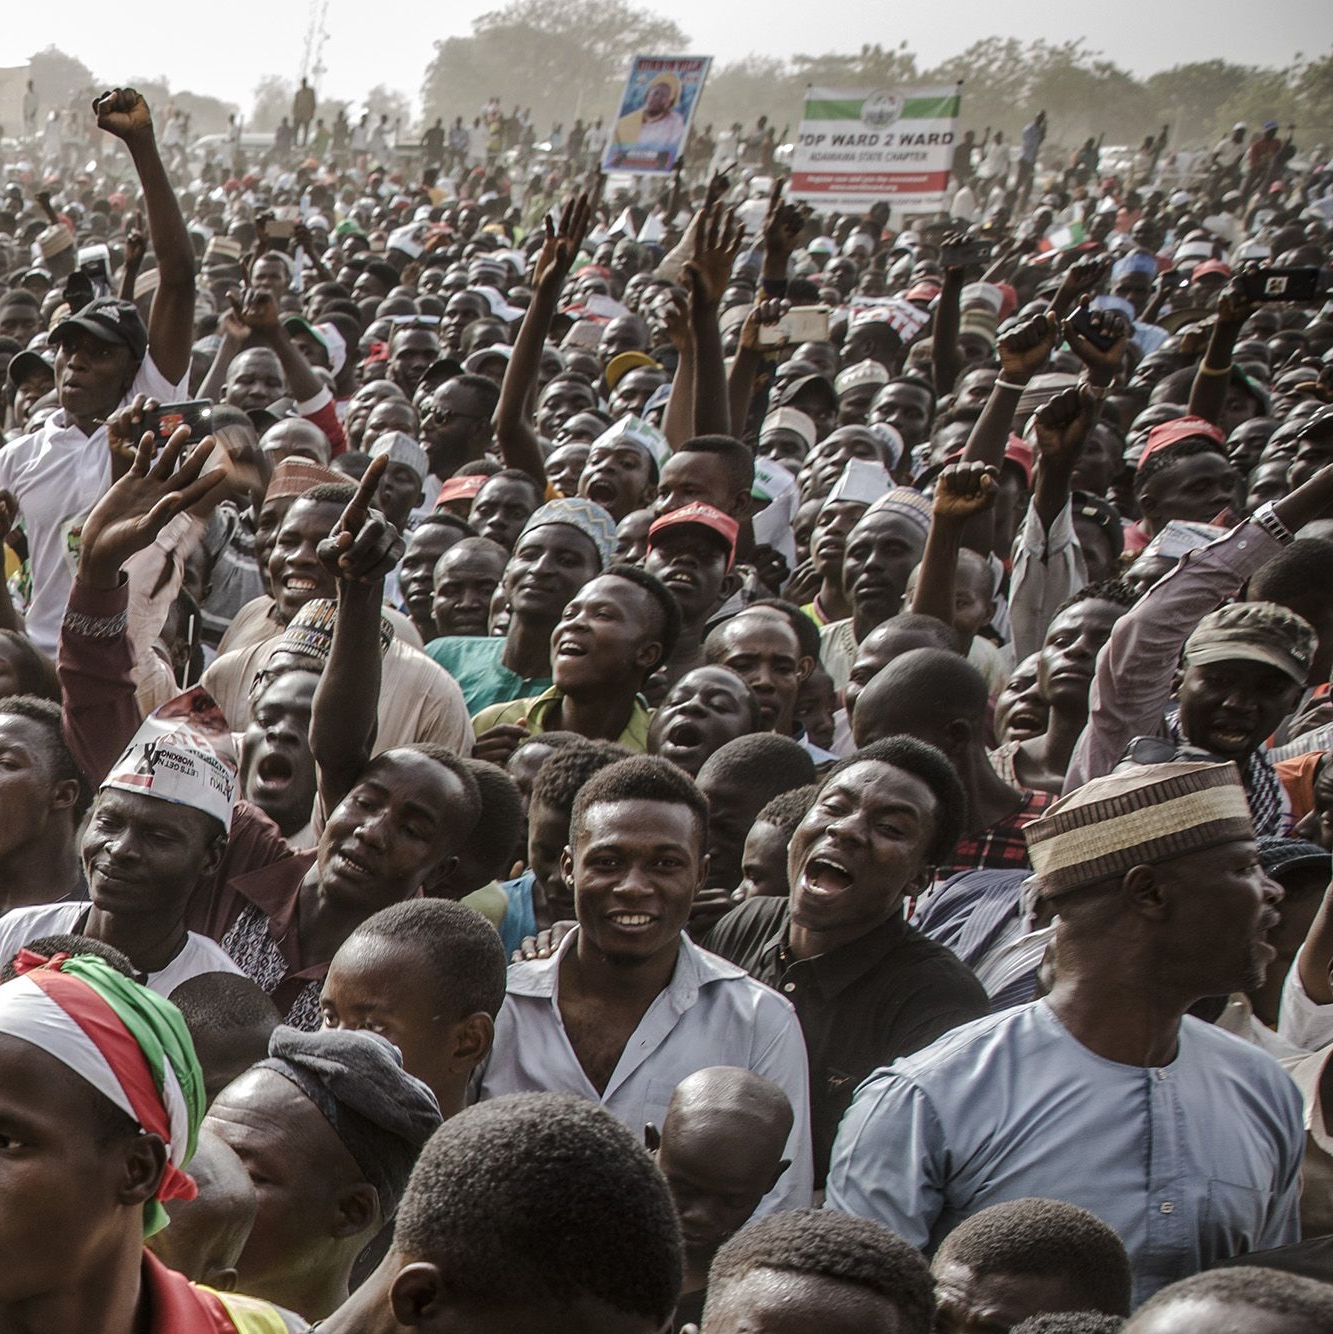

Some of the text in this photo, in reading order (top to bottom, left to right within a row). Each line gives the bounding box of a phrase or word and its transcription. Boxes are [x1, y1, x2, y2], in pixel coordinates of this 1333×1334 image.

[831, 133, 879, 147] WARD
[884, 134, 896, 146] 2
[899, 132, 955, 146] WARD
[858, 151, 883, 162] STATE
